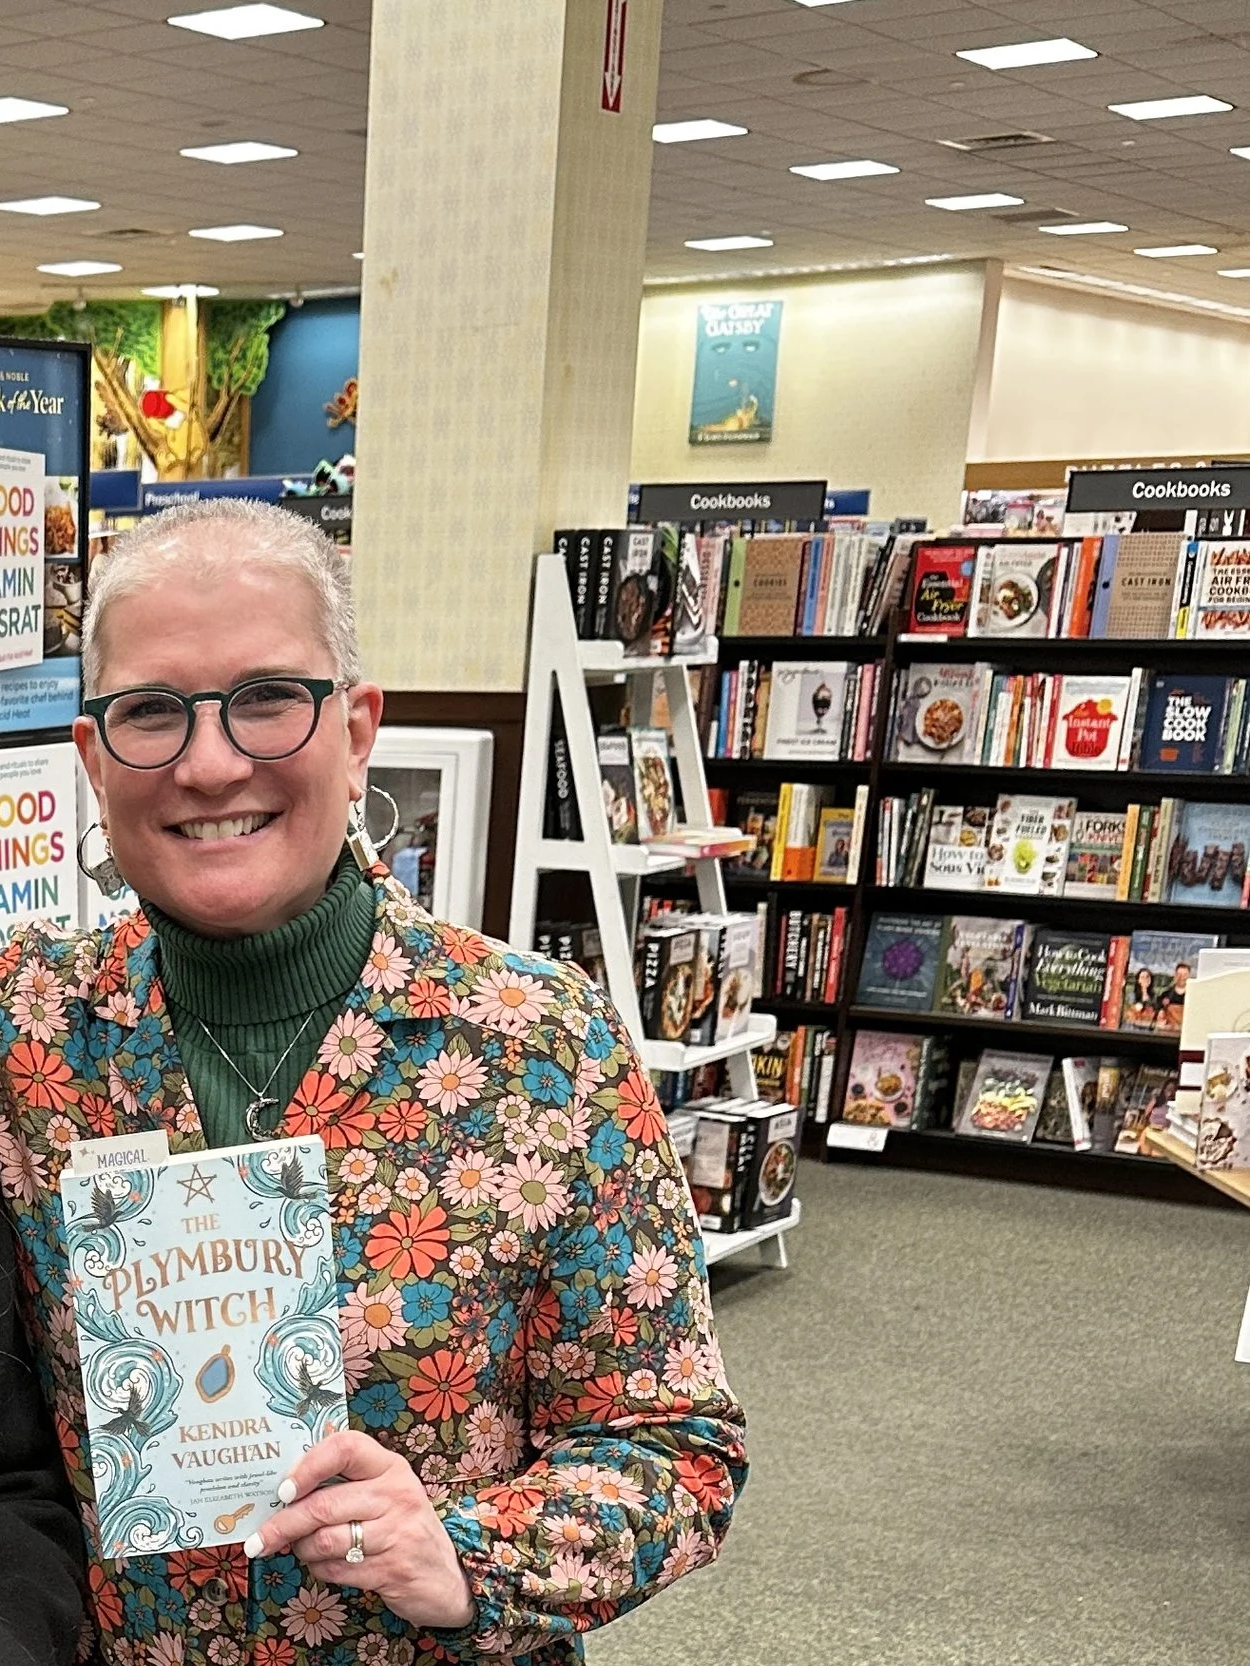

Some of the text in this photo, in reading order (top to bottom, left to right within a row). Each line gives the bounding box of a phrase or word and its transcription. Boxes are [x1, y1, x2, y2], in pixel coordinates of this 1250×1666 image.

[6, 371, 30, 382] NOBLE
[7, 391, 17, 415] of
[14, 390, 31, 411] the
[30, 389, 65, 415] Year
[1132, 480, 1231, 499] Cookbooks
[690, 493, 772, 510] Cookbooks
[577, 535, 590, 605] CAST IRON
[598, 535, 613, 605] CAST IRON
[1121, 577, 1172, 587] CAST IRON
[1211, 575, 1234, 585] AIR
[920, 588, 941, 600] Air
[930, 599, 964, 613] Fryer
[0, 682, 28, 695] recipes
[29, 681, 38, 690] to
[39, 679, 59, 690] enjoy
[31, 692, 47, 704] chef
[48, 690, 74, 703] behind
[1166, 695, 1193, 708] THE
[12, 709, 31, 719] Heat
[1164, 705, 1212, 720] SLOW
[1068, 716, 1111, 728] Instant
[1162, 718, 1208, 731] COOK
[1076, 729, 1097, 743] Pot
[1161, 729, 1206, 742] BOOK
[554, 738, 568, 799] SEAFOOD
[931, 848, 984, 864] How to
[785, 910, 802, 970] BUTCHERY
[645, 943, 660, 989] PIZZA
[1036, 957, 1106, 979] Everything
[1034, 972, 1102, 993] Vegetarian
[1029, 1002, 1100, 1021] Mark Bittman
[96, 1148, 148, 1169] MAGICAL
[181, 1212, 221, 1235] THE
[102, 1237, 307, 1311] PLYMBURY
[136, 1286, 278, 1337] WITCH
[178, 1416, 273, 1444] KENDRA
[171, 1440, 282, 1470] VAUGHAN
[204, 1489, 275, 1503] ELIZABETH WATSON
